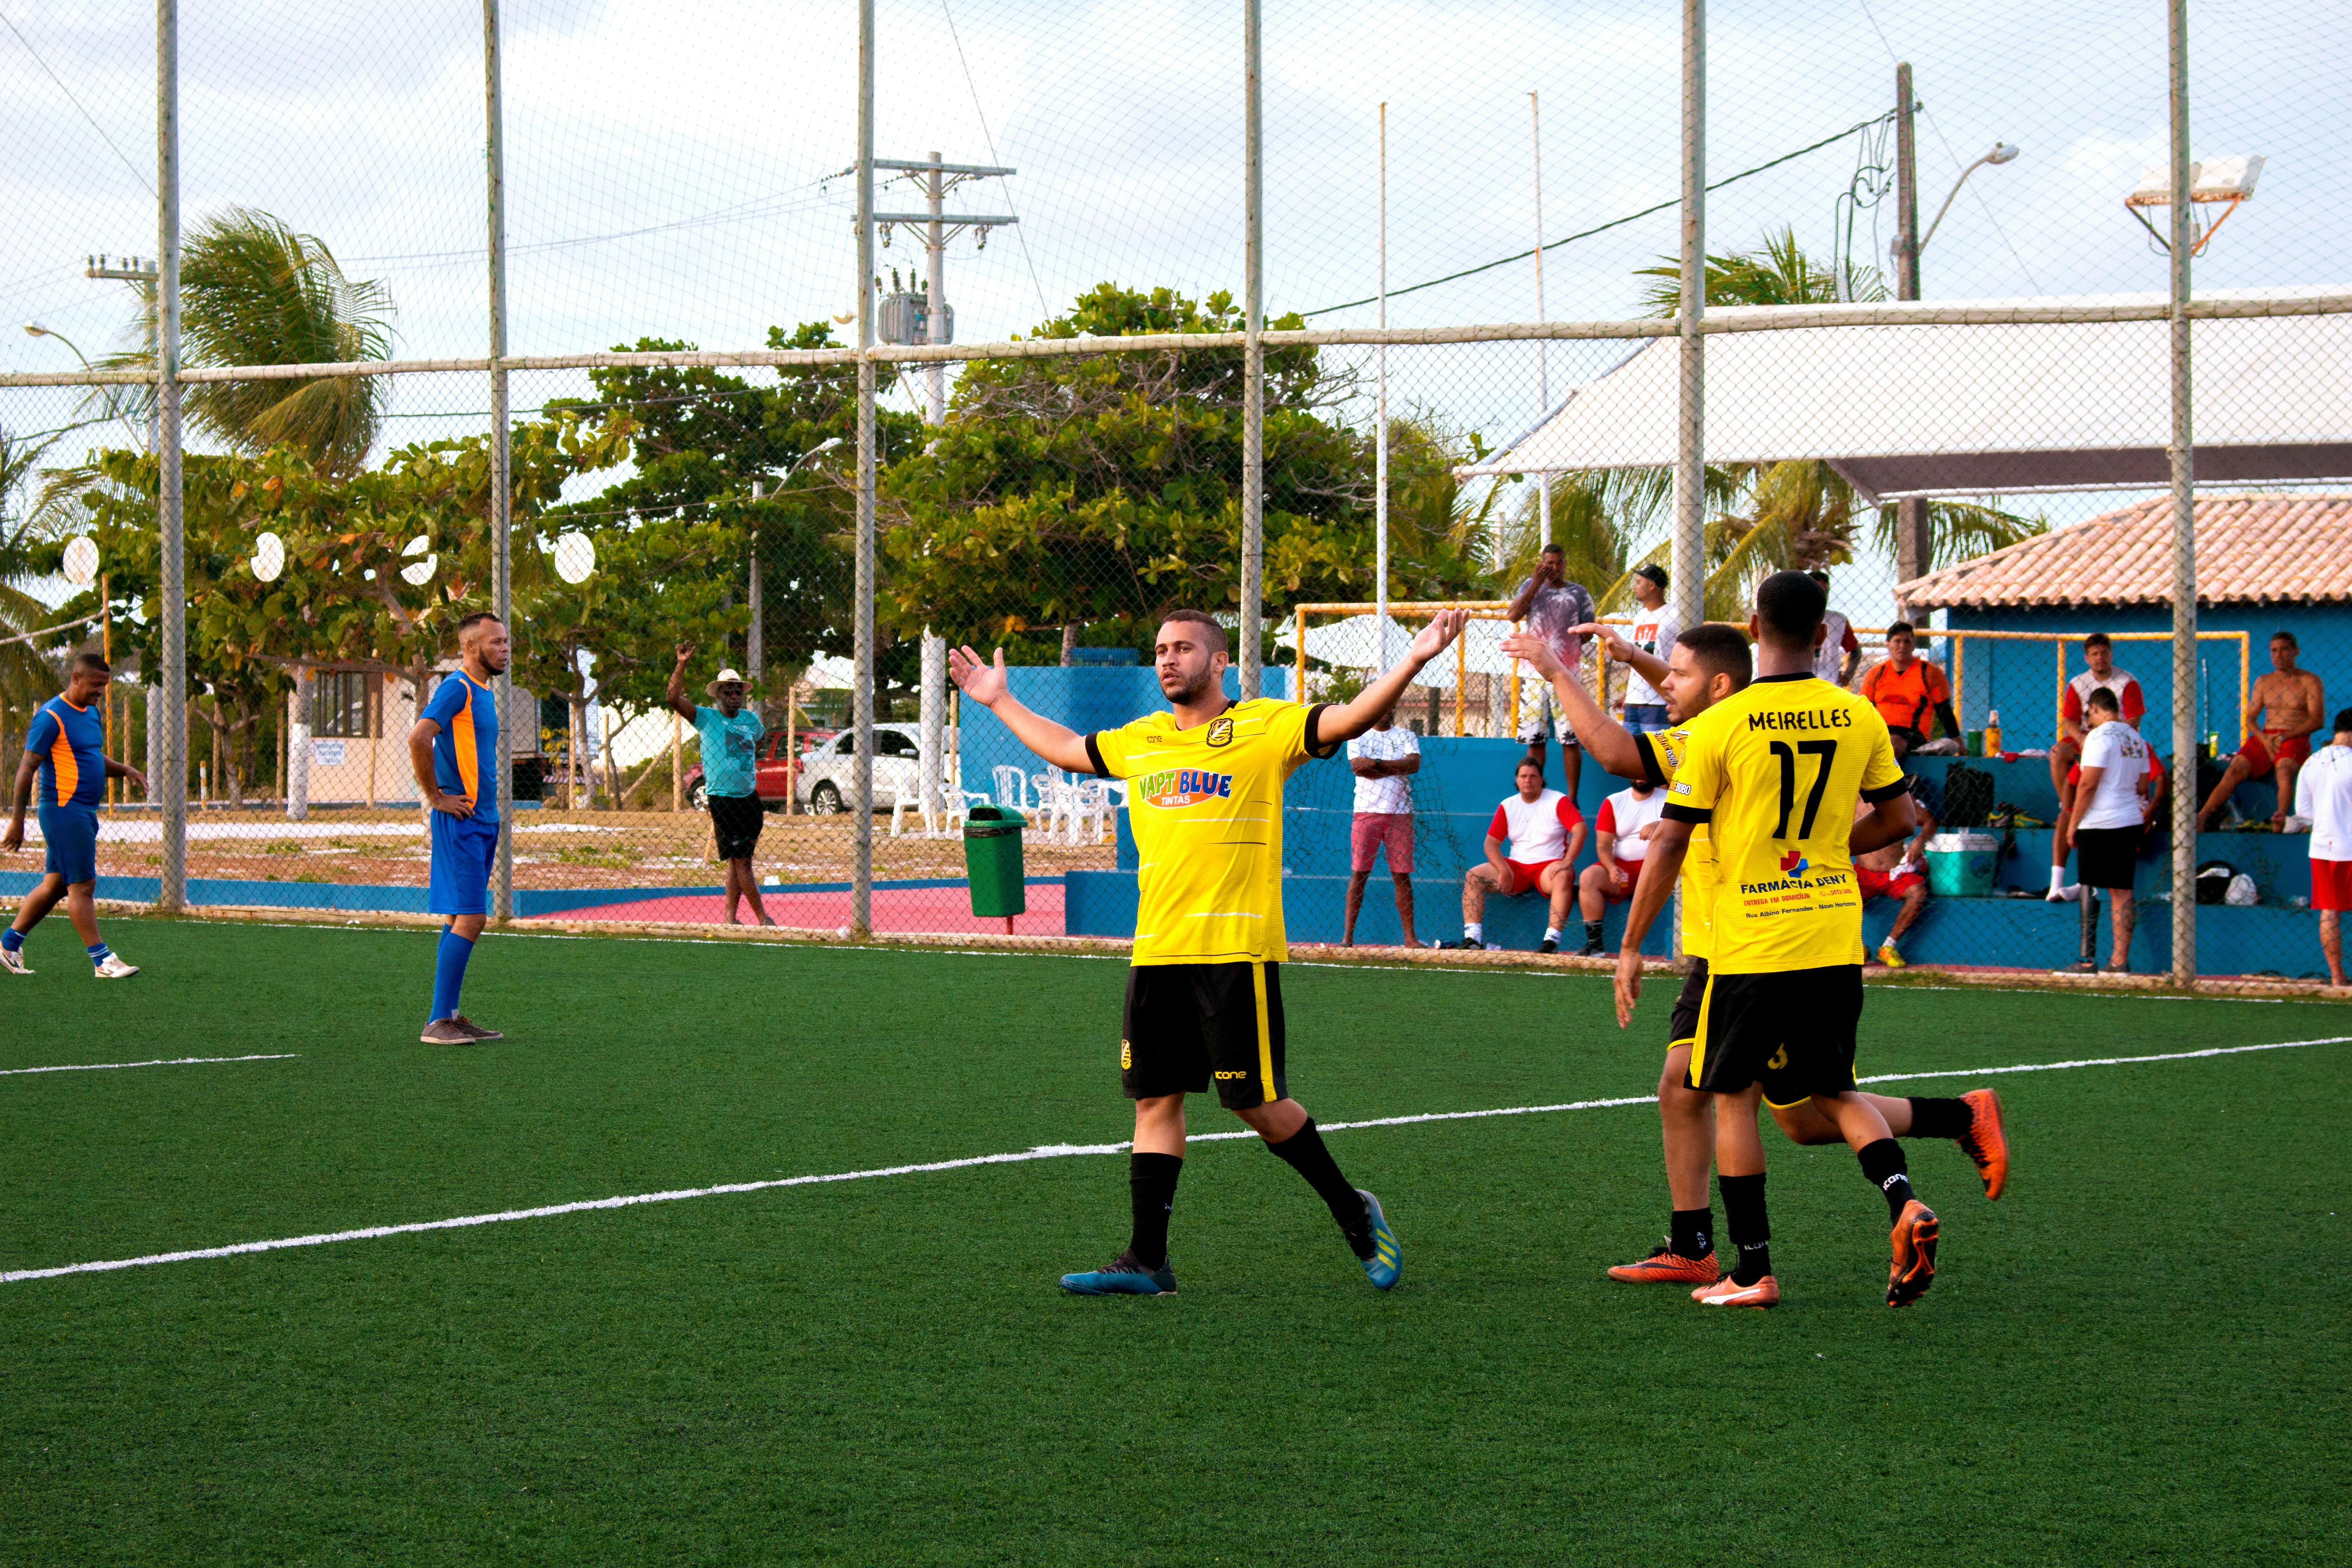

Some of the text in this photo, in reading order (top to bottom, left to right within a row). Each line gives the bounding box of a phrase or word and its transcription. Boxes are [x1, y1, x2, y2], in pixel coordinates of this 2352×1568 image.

[1748, 708, 1851, 731] MEIRELLES
[1139, 771, 1233, 800] VAPT BLUE
[1675, 781, 1691, 795] BOBO
[1769, 739, 1837, 840] 17
[1161, 795, 1191, 806] TINTAS
[1740, 874, 1846, 894] FARMÁCIA DENY
[1781, 892, 1810, 902] DOMICÍLIO
